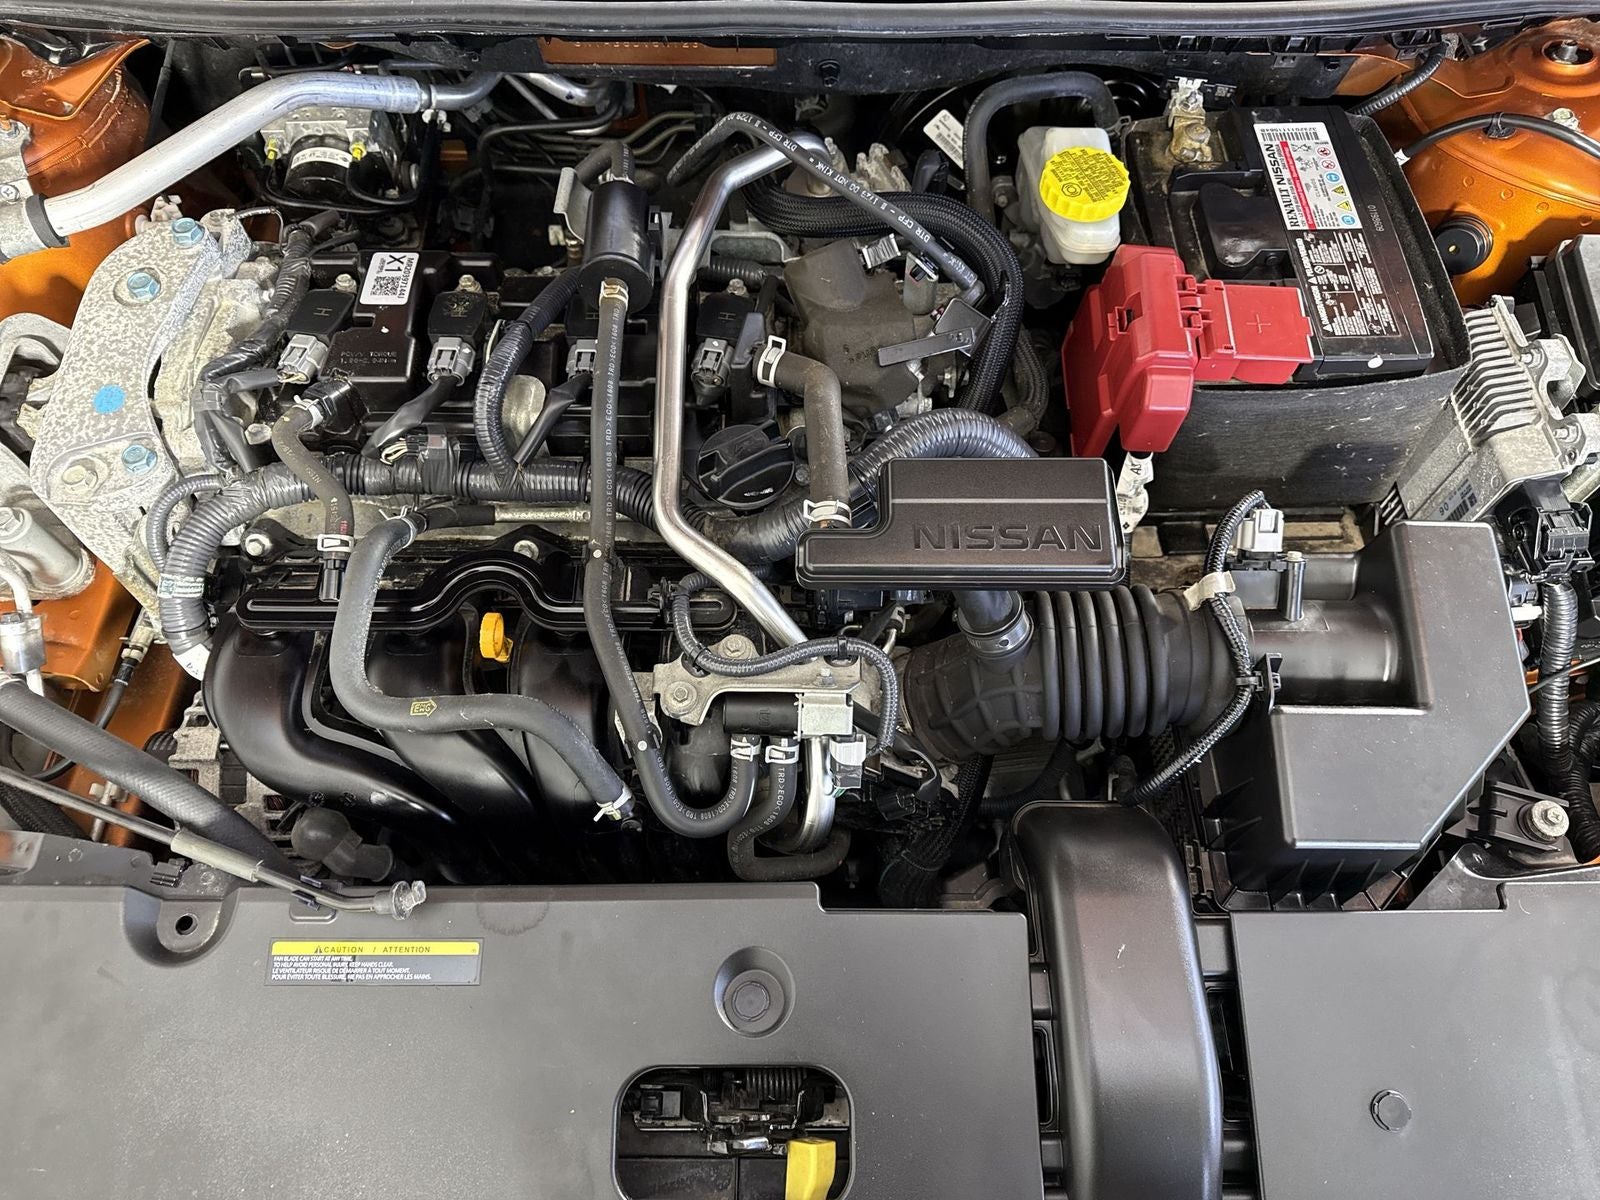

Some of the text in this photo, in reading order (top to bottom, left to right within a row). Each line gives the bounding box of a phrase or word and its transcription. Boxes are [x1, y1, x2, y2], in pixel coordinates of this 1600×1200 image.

[768, 131, 782, 141] CFP
[783, 139, 798, 152] DTR
[816, 162, 833, 176] KINK
[1263, 143, 1286, 185] NISSAN
[834, 175, 848, 187] NOT
[850, 184, 860, 193] DO
[1277, 187, 1300, 227] RENAULT
[898, 216, 914, 228] CFP
[916, 230, 930, 243] DTR
[385, 254, 407, 271] X1
[914, 524, 1102, 551] NISSAN
[414, 703, 430, 713] ENG
